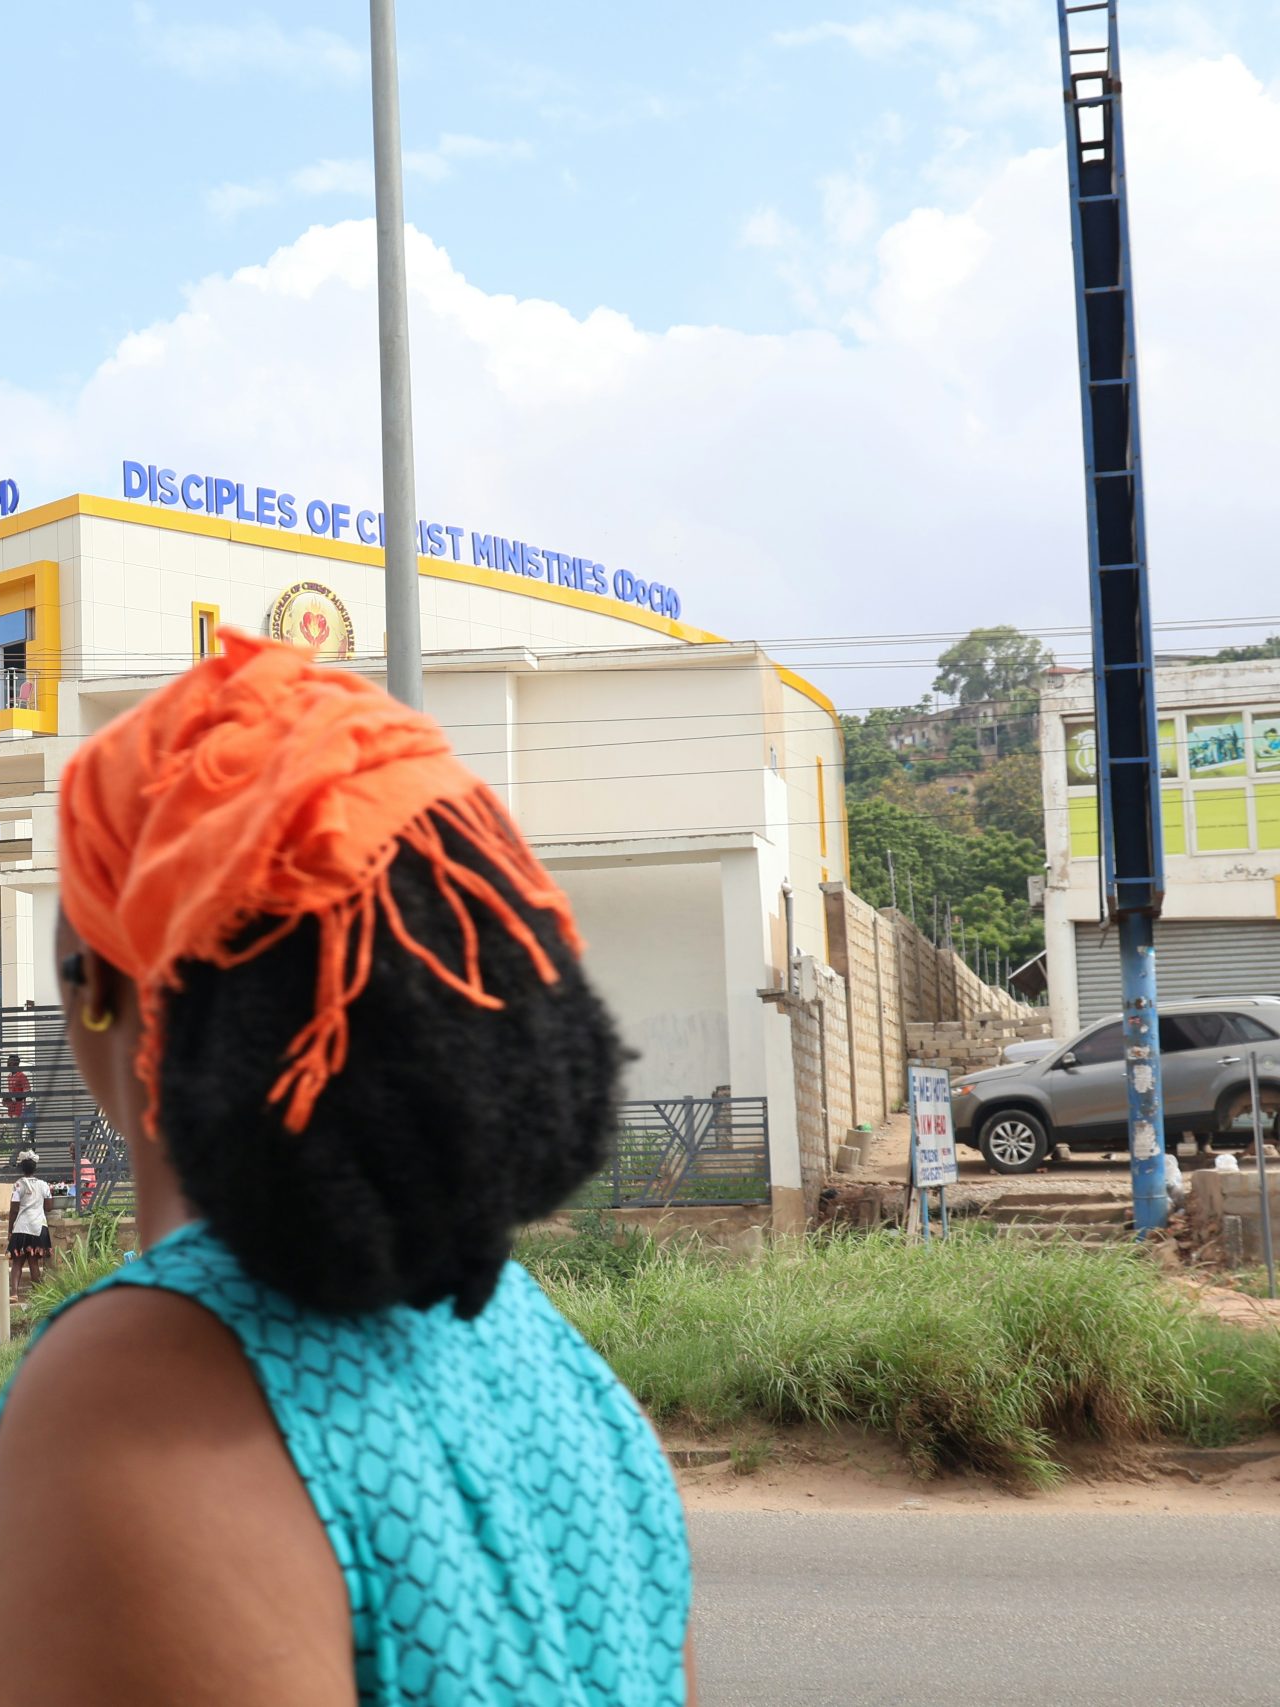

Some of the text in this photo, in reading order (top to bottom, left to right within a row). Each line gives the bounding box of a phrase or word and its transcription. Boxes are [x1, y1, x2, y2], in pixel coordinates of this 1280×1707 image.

[122, 460, 298, 529] DISCIPLES
[306, 500, 351, 538] OF
[356, 509, 465, 561] CIST
[471, 531, 609, 595] MINISTRIES
